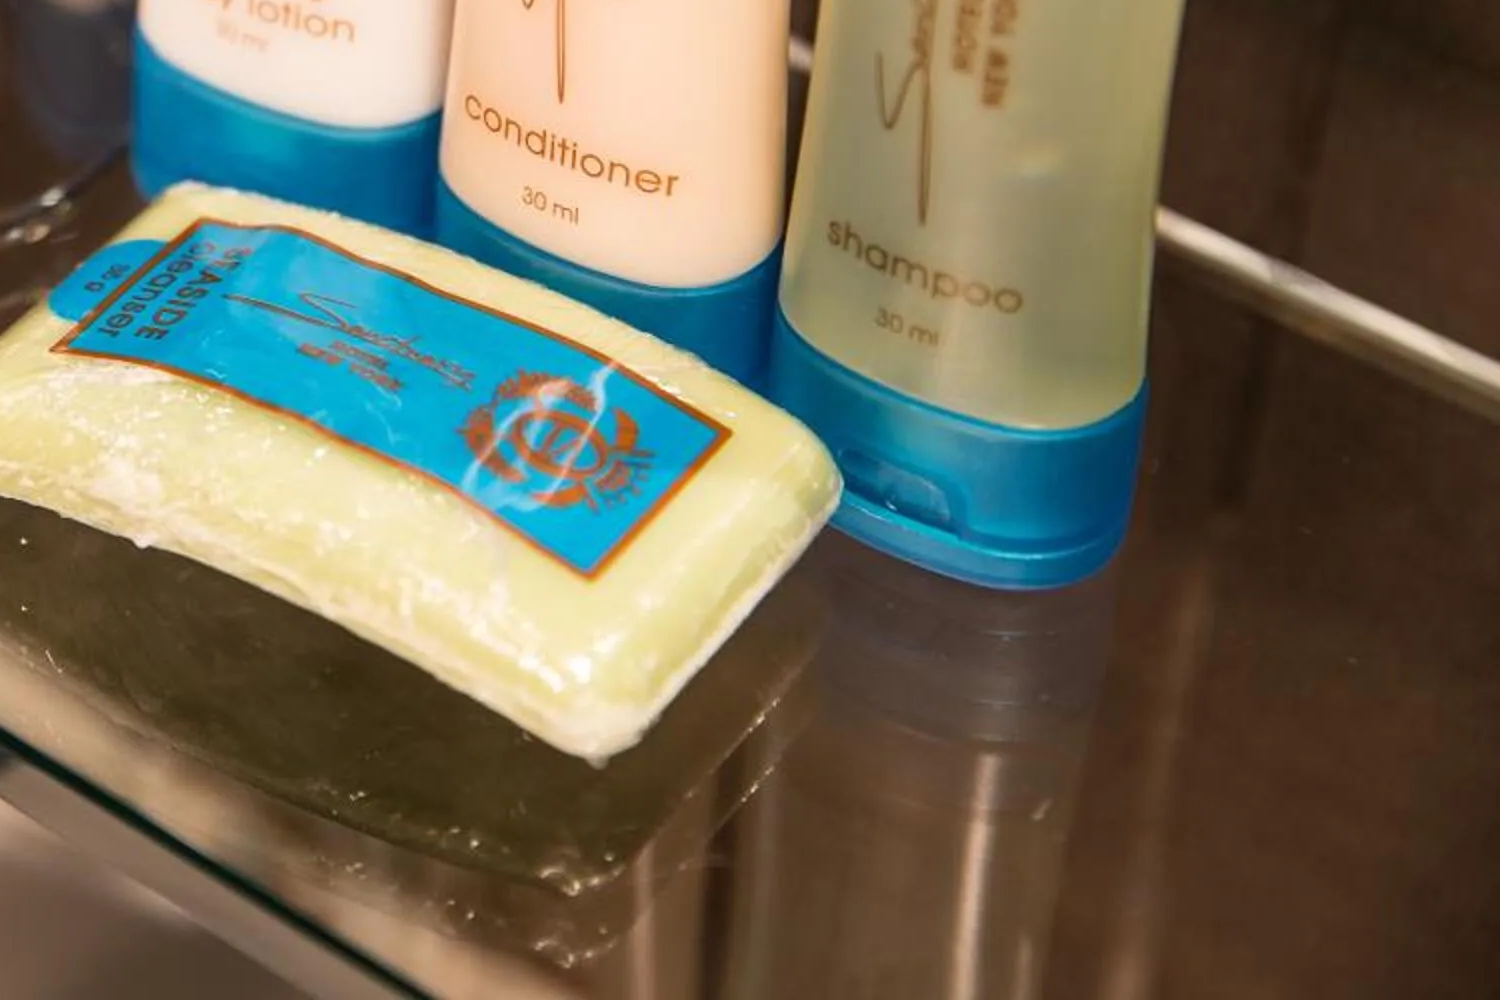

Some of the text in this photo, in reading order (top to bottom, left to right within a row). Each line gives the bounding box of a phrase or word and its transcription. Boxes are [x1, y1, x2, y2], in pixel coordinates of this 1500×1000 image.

[465, 94, 679, 197] conditioner
[522, 185, 579, 225] 30 ml
[827, 220, 1023, 314] shampoo
[874, 306, 939, 347] 30 ml
